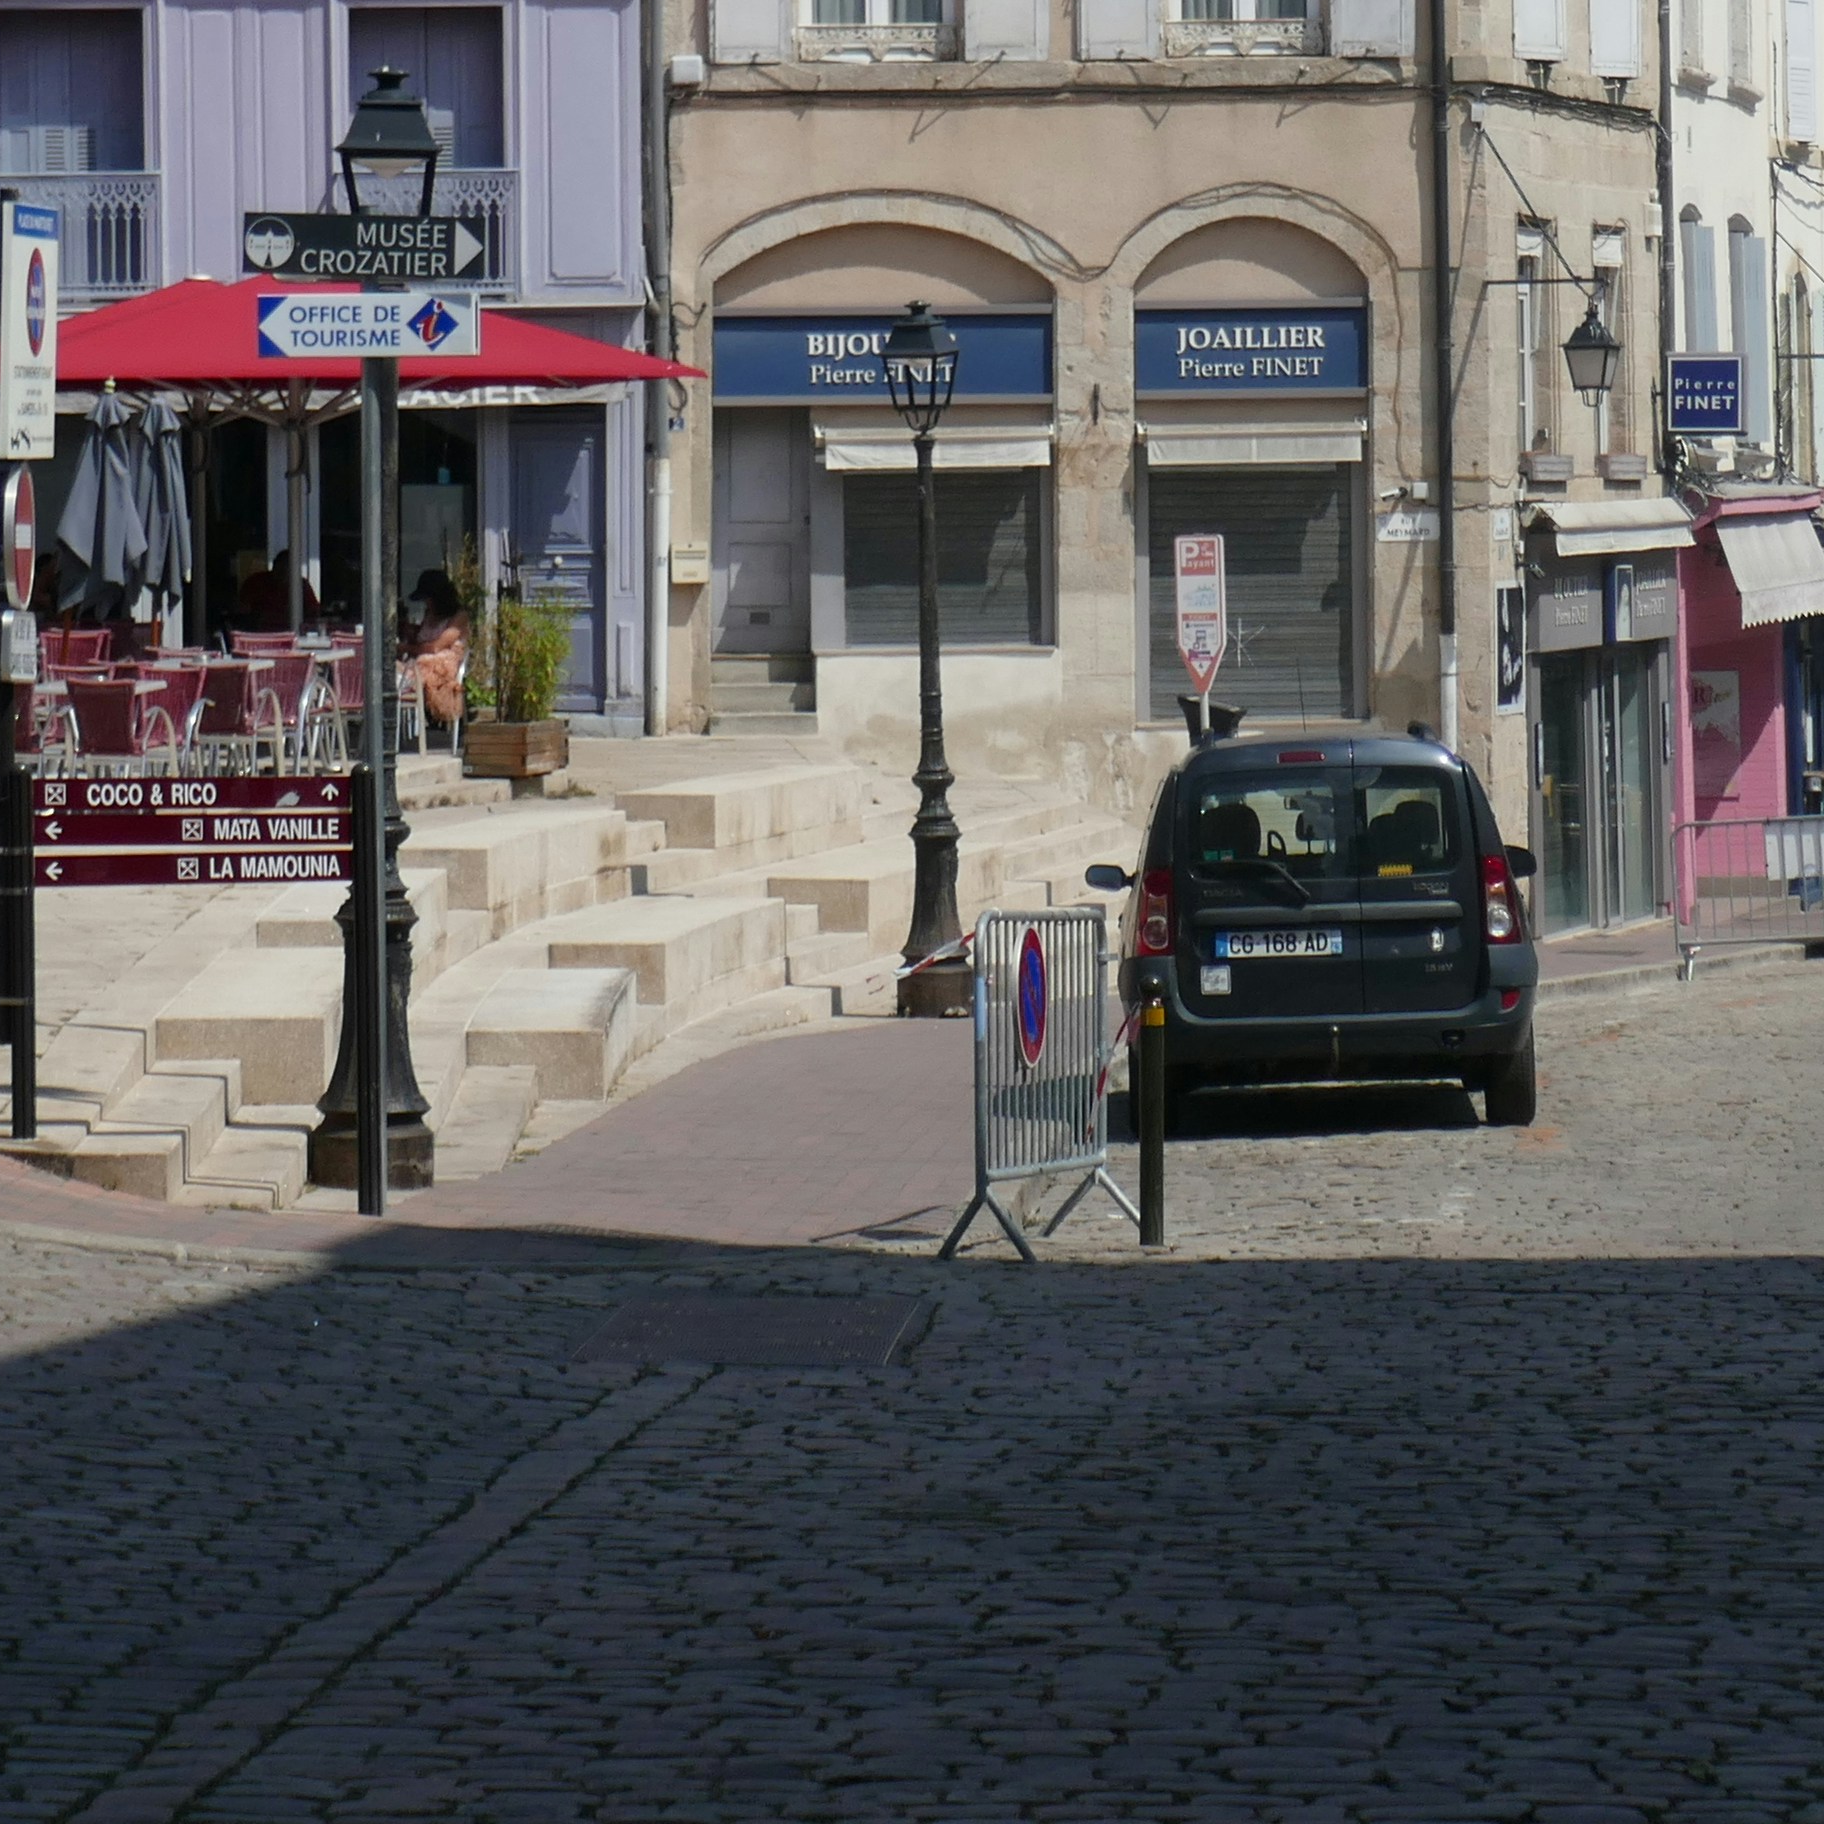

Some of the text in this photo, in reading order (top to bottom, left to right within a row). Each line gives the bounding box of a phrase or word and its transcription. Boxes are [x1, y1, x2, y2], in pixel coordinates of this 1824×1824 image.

[356, 219, 447, 249] MUSÉE
[300, 249, 447, 276] CROZATIER
[289, 305, 401, 324] OFFICE DE
[290, 329, 401, 347] TOURISME
[1176, 326, 1325, 354] JOAILLIER
[809, 364, 876, 384] Pierre
[1179, 356, 1324, 377] Pierre FINET
[1674, 378, 1735, 390] Pierre
[1674, 395, 1735, 410] FINET
[87, 783, 217, 807] COCO & RICO
[214, 818, 340, 841] MATA VANILLE
[209, 855, 341, 879] LA MAMOUNIA
